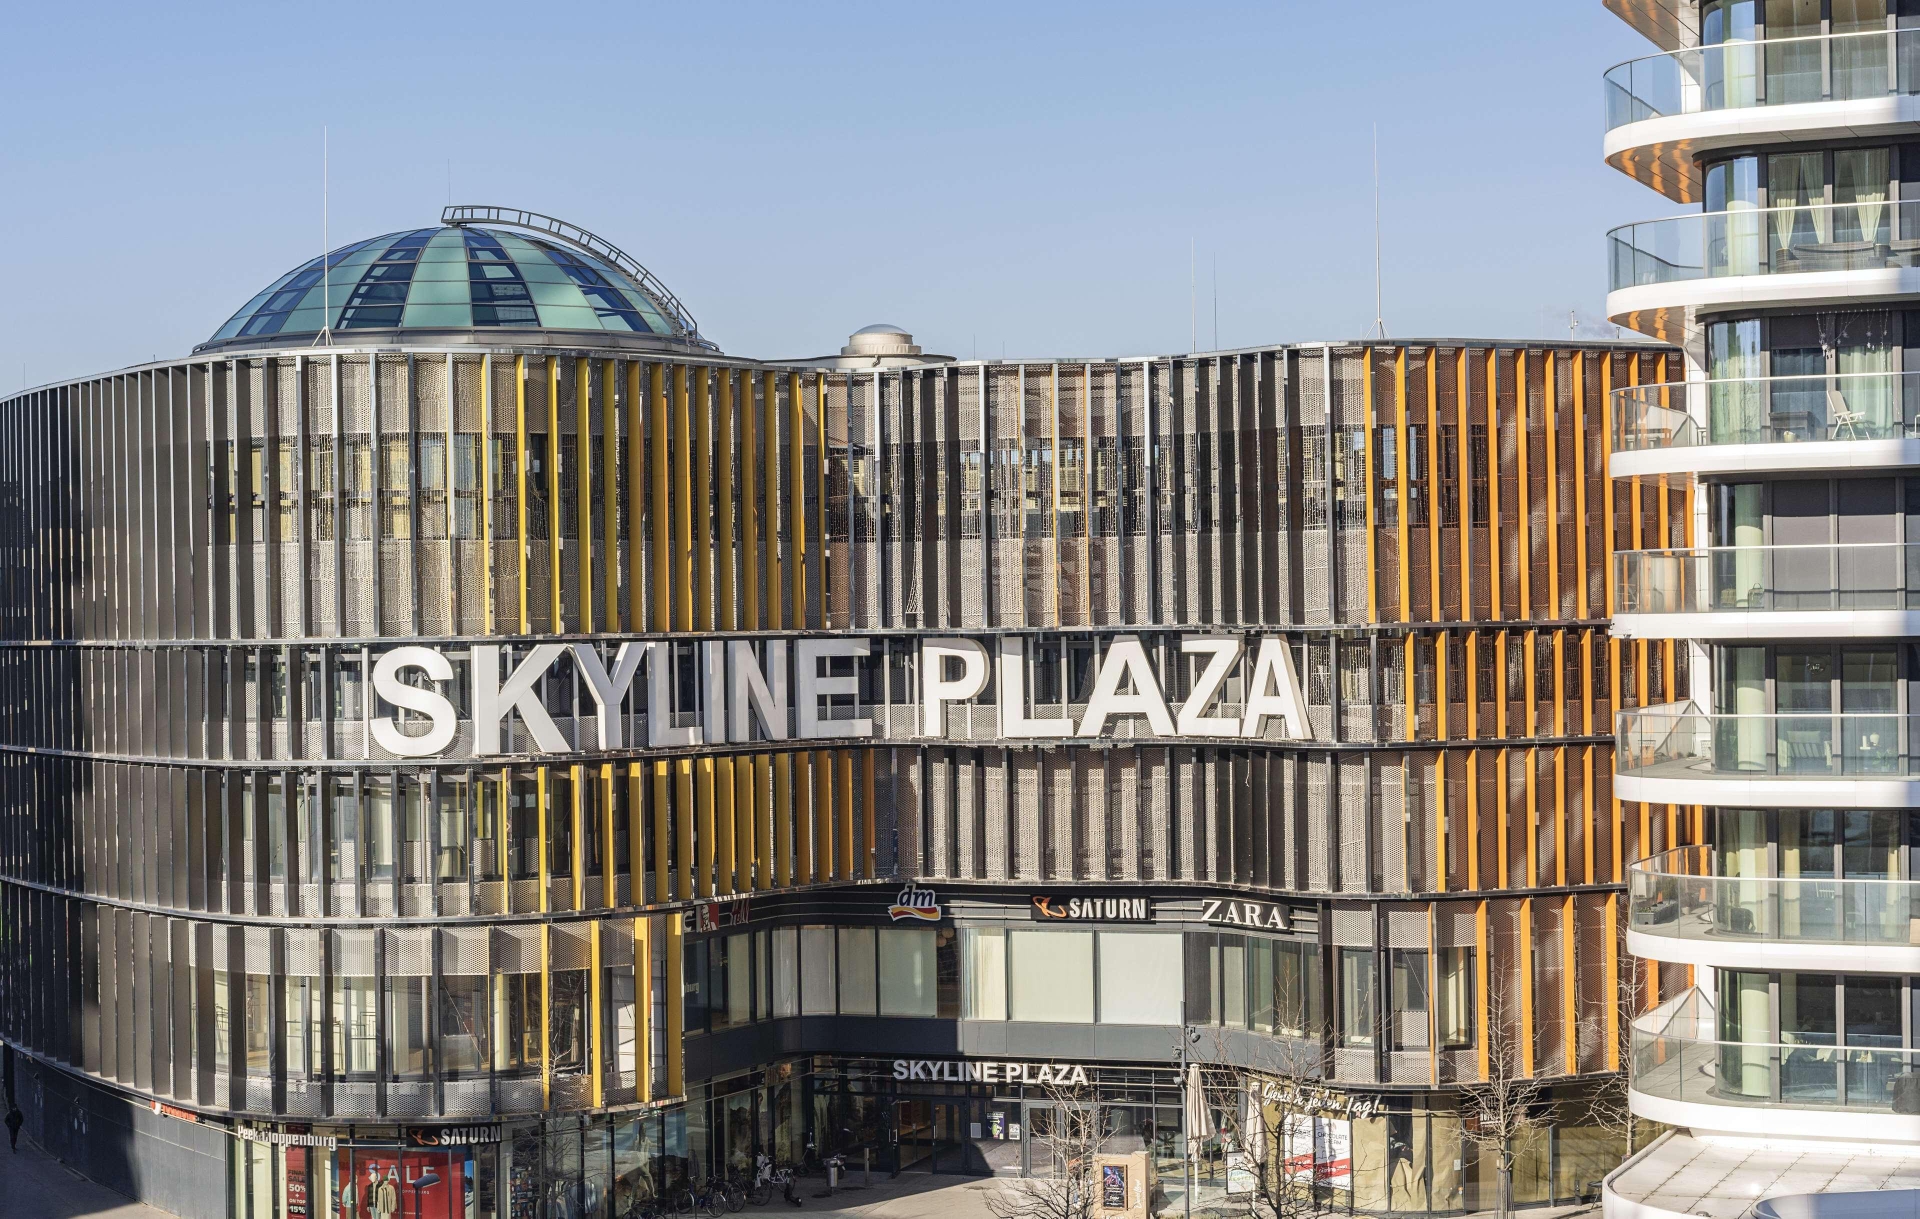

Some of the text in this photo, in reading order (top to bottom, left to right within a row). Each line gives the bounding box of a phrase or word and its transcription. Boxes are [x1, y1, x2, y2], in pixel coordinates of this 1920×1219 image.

[369, 633, 1313, 757] SKYLINE PLAZA
[896, 884, 936, 908] dm
[1069, 896, 1147, 920] SATURN
[1201, 898, 1290, 931] ZARA
[892, 1059, 1089, 1086] SKYLINE PLAZA
[440, 1125, 501, 1146] SATURN
[289, 1206, 306, 1214] 15%
